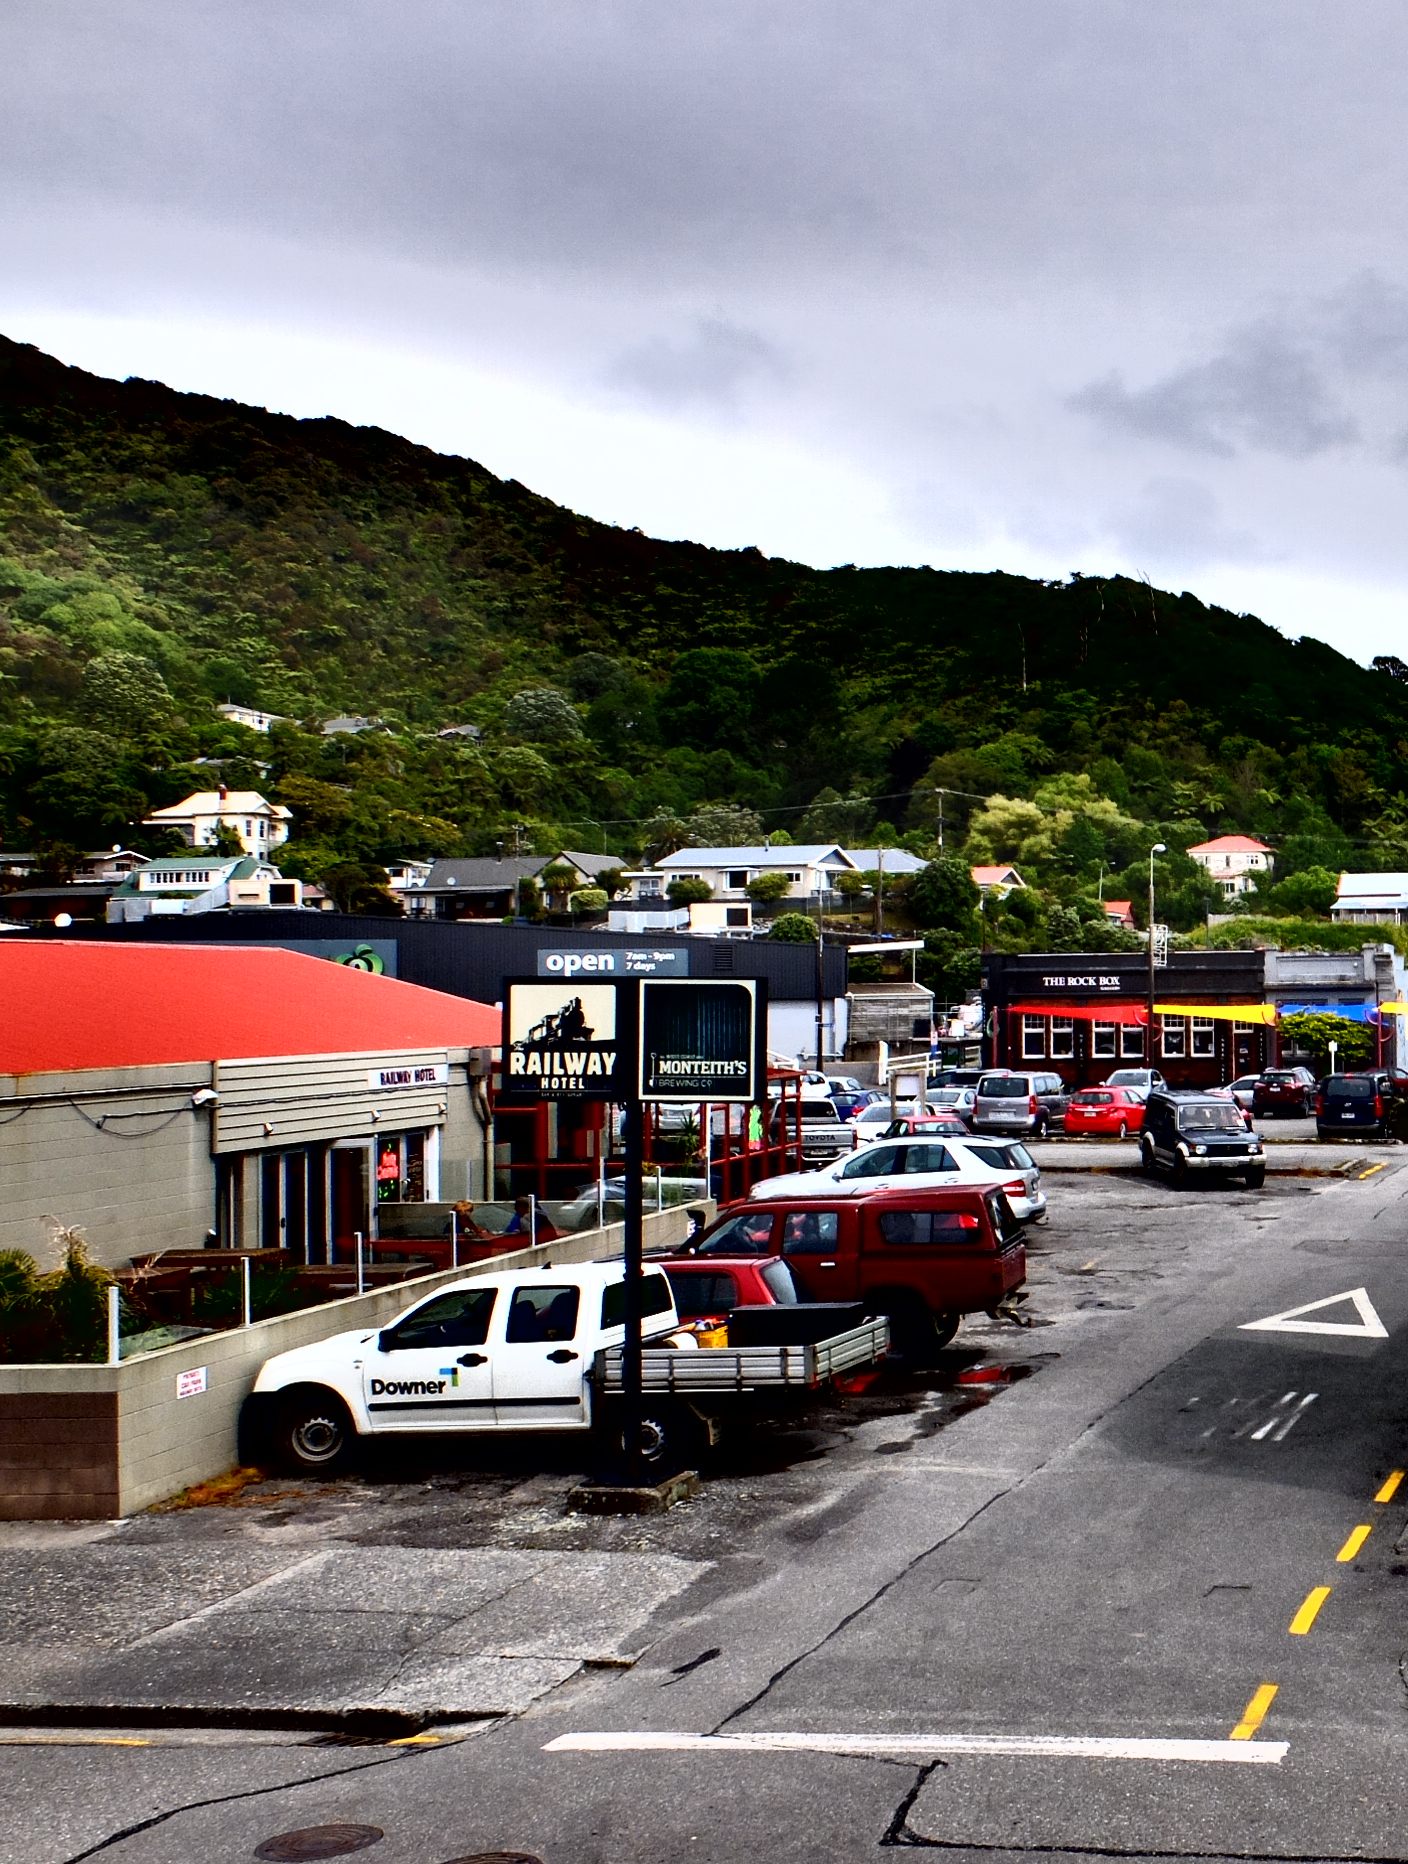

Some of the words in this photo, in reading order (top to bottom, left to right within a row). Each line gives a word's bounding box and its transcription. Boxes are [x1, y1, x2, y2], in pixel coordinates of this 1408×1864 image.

[546, 953, 615, 976] open
[625, 962, 633, 970] 7
[633, 961, 656, 972] days
[1042, 976, 1066, 986] THE
[1067, 976, 1097, 986] ROCK
[1098, 976, 1121, 986] BOX
[510, 1052, 616, 1076] RAILWAY
[658, 1060, 747, 1075] MONTEITH'S
[380, 1069, 412, 1086] RAILWAY
[414, 1068, 436, 1082] HOTEL
[541, 1077, 585, 1089] HOTEL
[658, 1079, 699, 1087] BREWING
[371, 1378, 447, 1395] Downer
